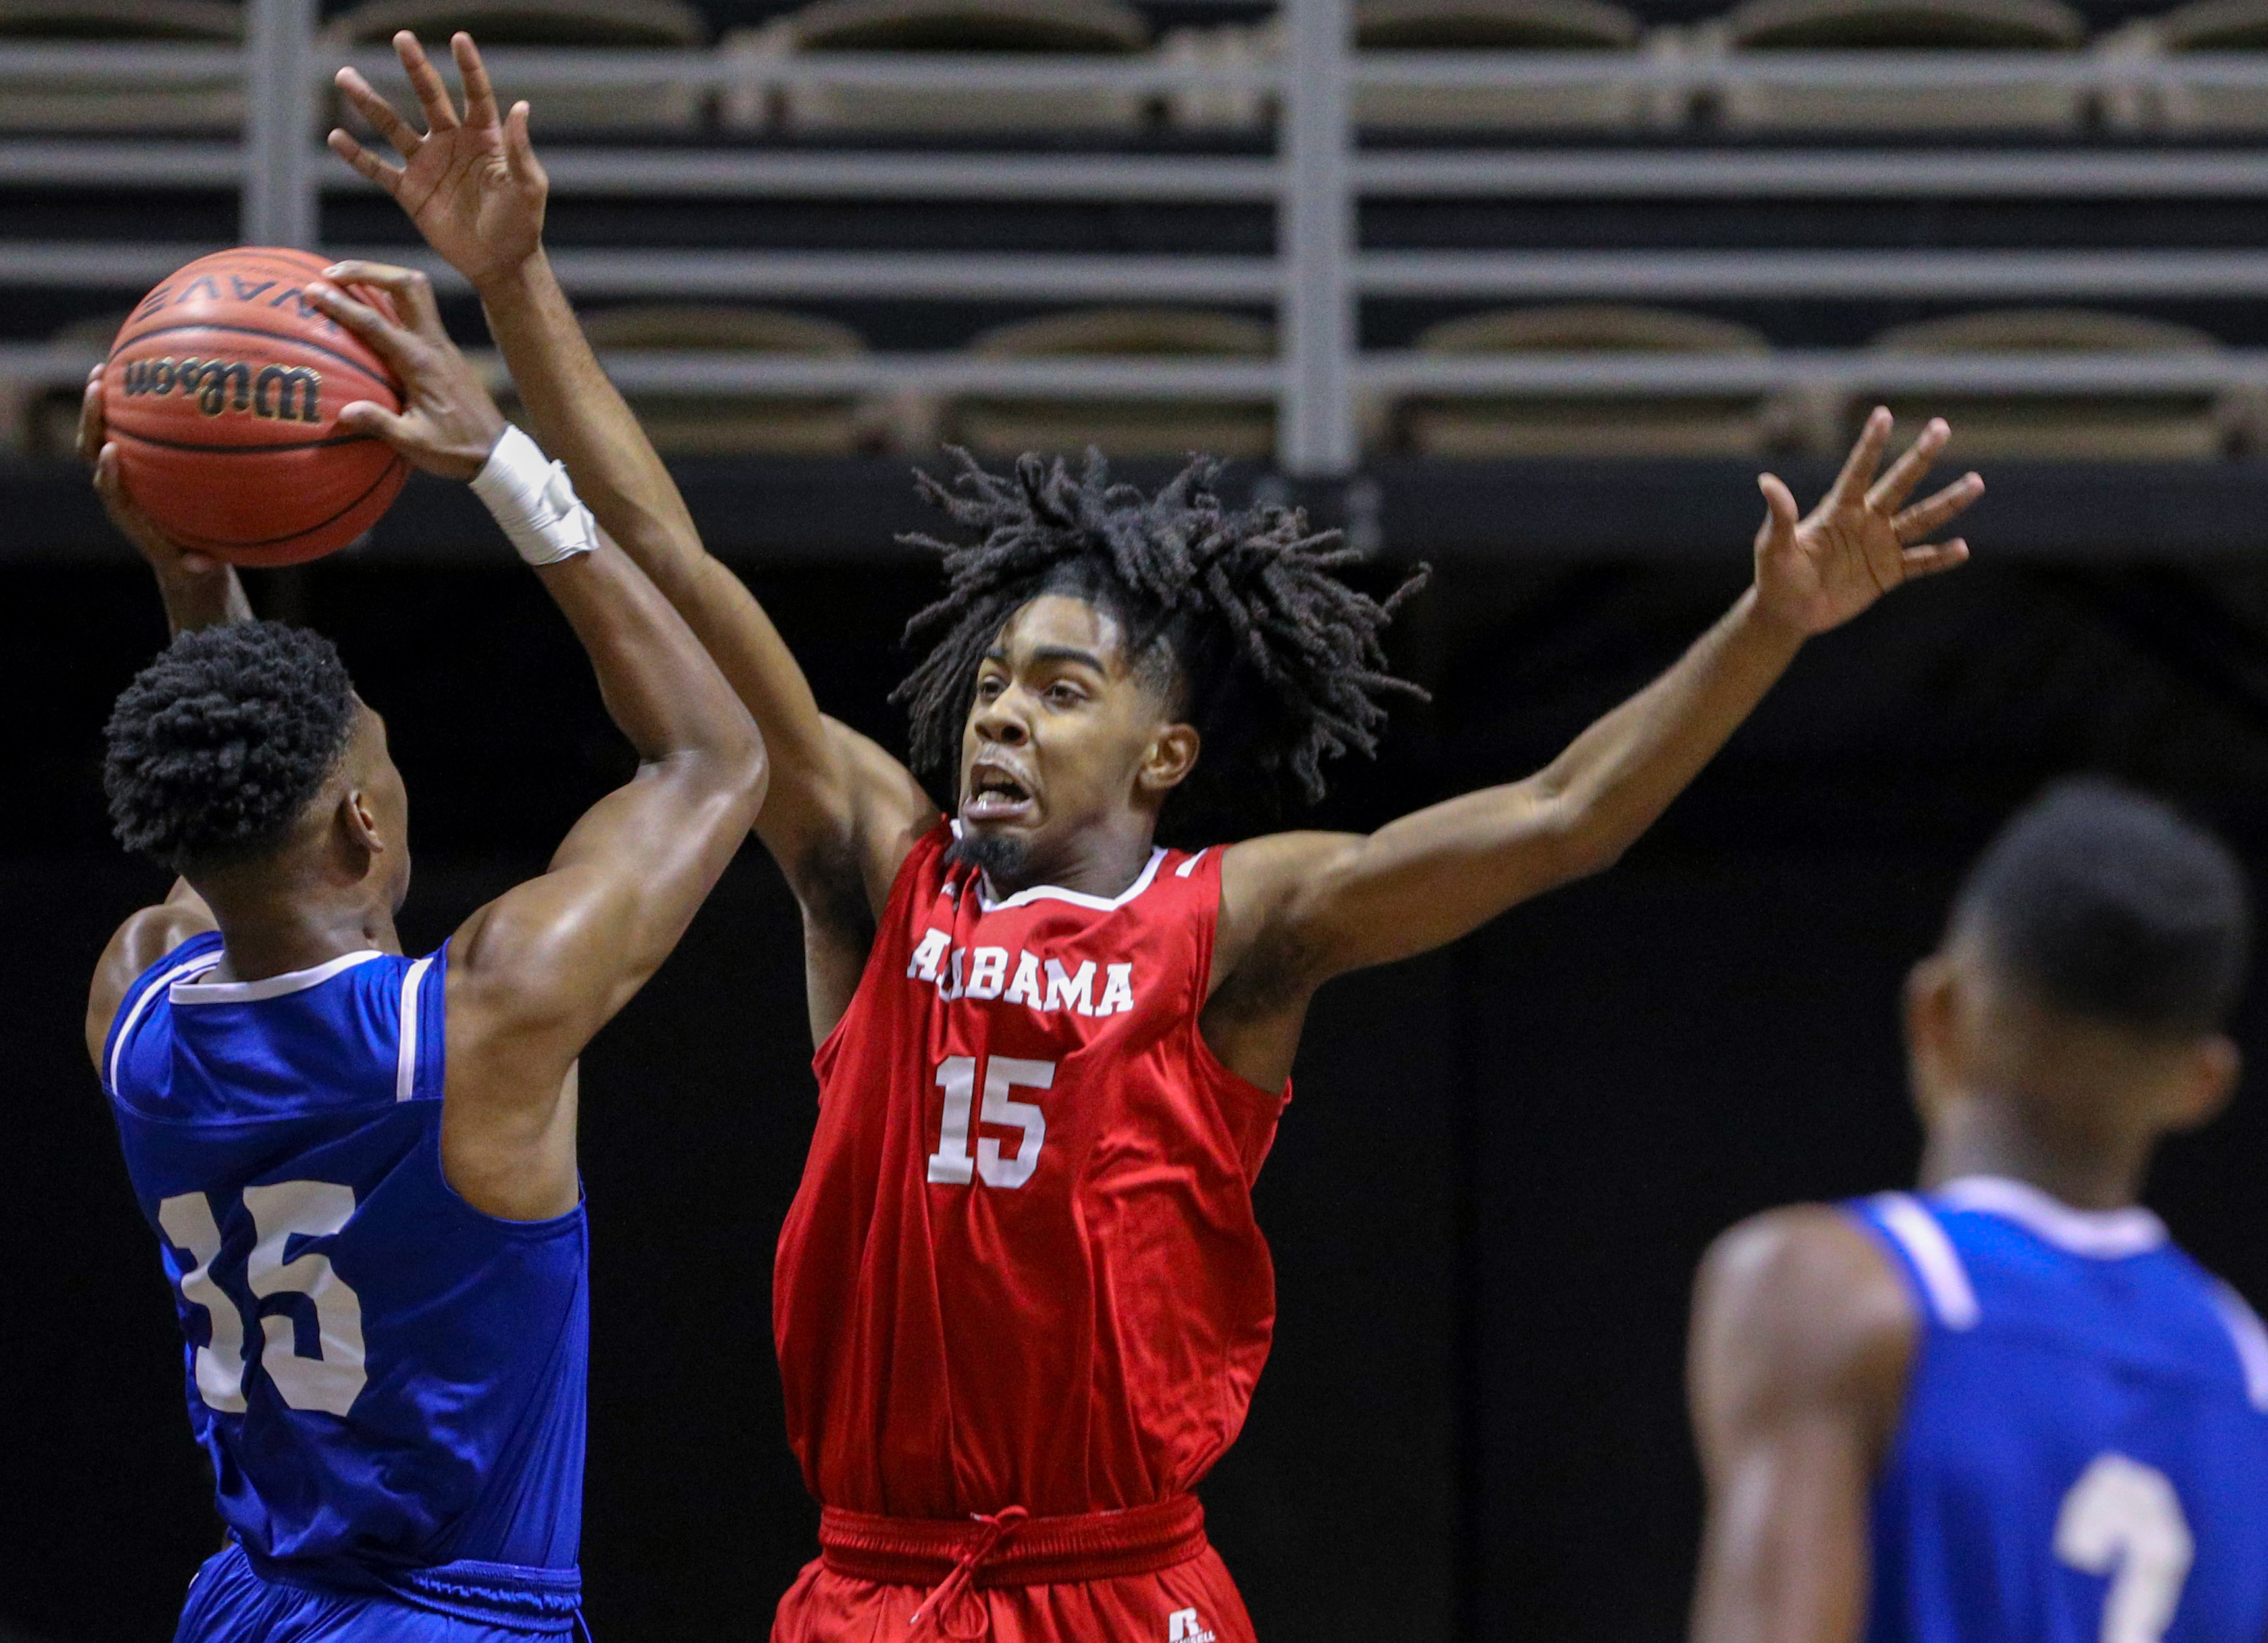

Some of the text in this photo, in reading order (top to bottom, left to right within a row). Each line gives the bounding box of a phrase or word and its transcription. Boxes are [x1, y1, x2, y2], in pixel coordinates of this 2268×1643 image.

[136, 274, 337, 332] WAVE
[125, 356, 324, 423] Wilson
[927, 1055, 1056, 1189] 15
